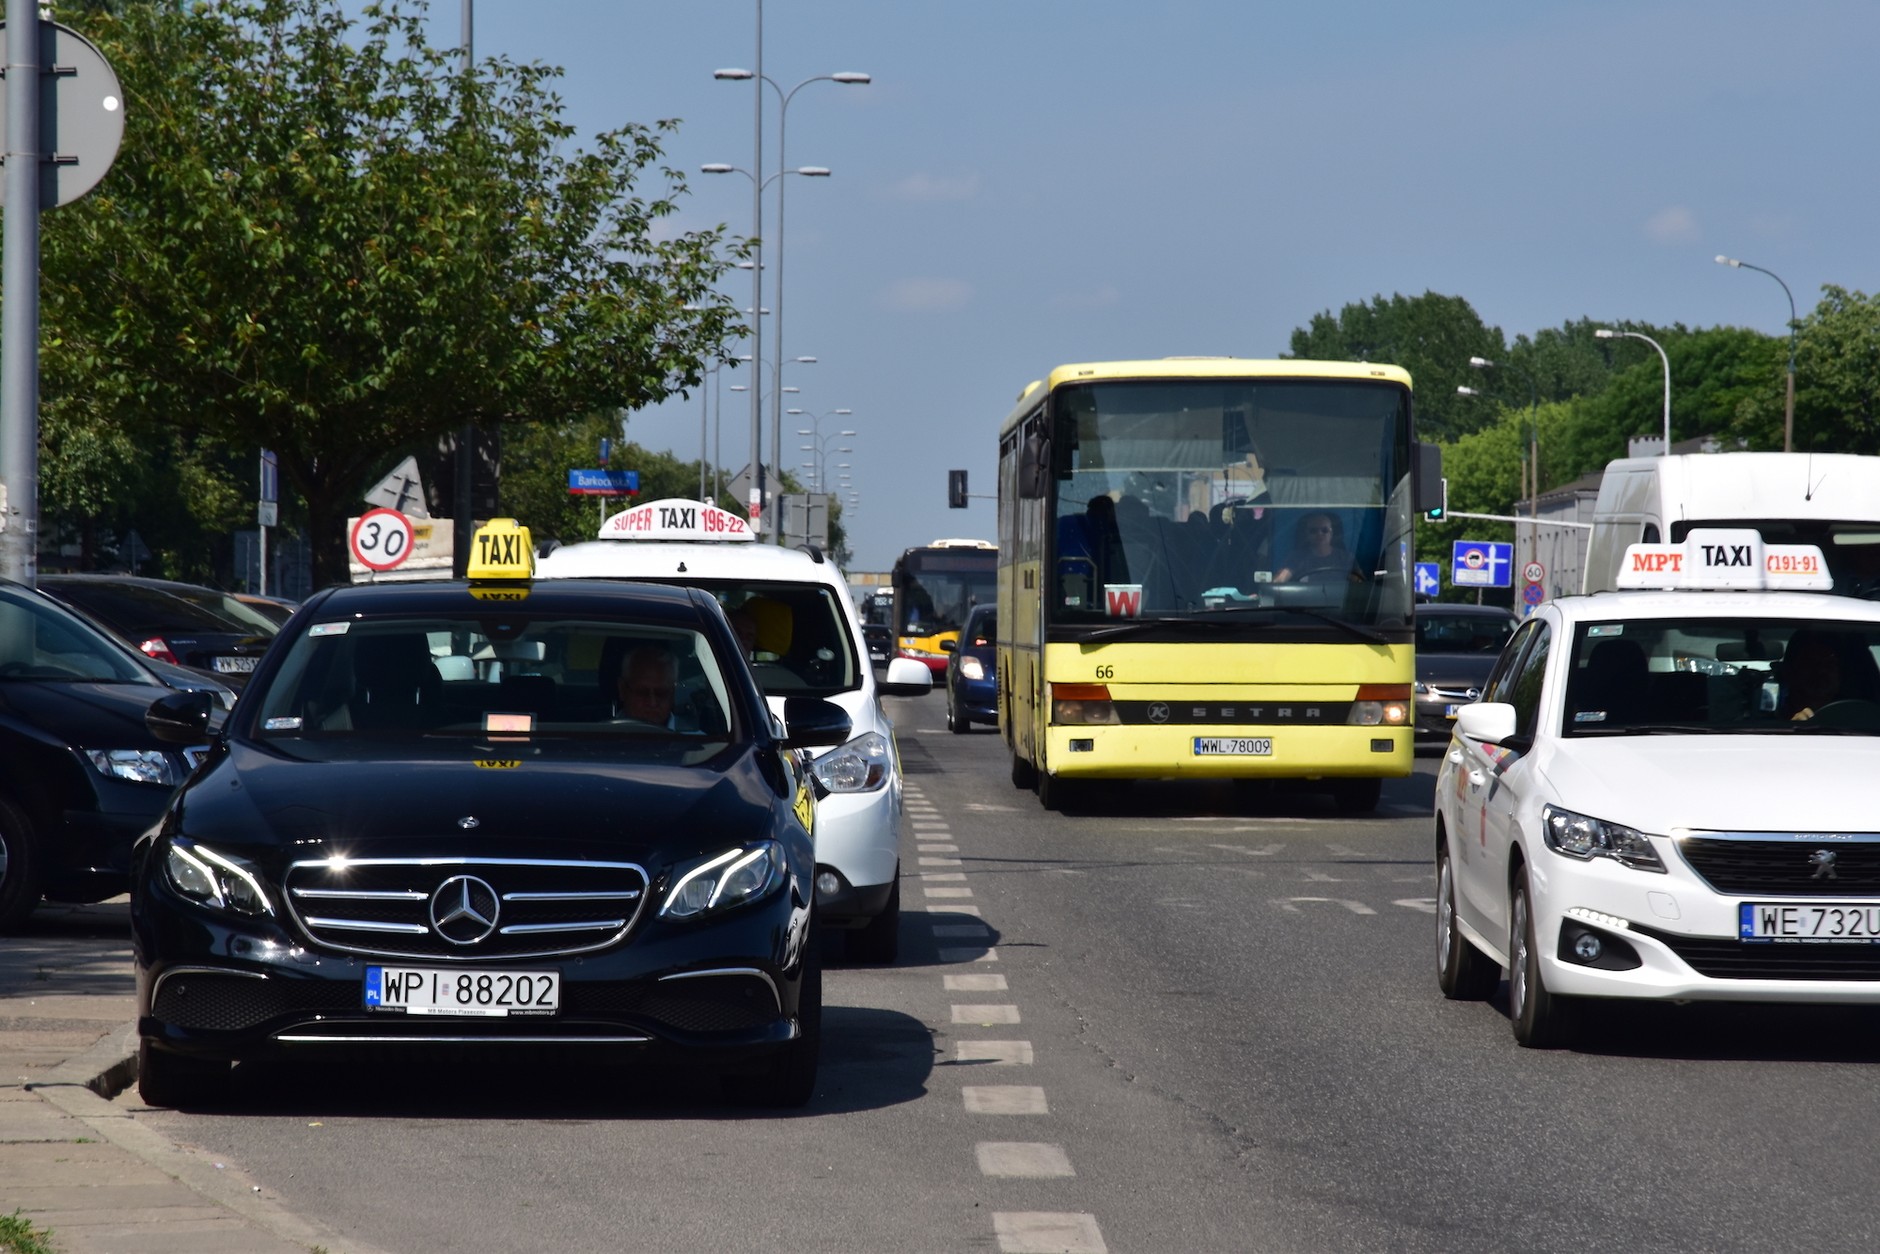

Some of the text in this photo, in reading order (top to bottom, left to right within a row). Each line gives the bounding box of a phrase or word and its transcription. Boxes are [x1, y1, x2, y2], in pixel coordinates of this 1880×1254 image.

[614, 507, 653, 531] SUPER
[659, 507, 696, 529] TAXI
[701, 508, 745, 533] 196-22
[360, 522, 405, 557] 30
[478, 534, 521, 565] TAXI
[1632, 545, 1818, 572] MPT TAXI 191-91
[1527, 567, 1541, 578] 60
[1107, 591, 1141, 618] W
[1095, 664, 1114, 679] 66
[1192, 707, 1321, 718] SETRA
[1201, 740, 1271, 754] WWL 78009
[1741, 924, 1753, 933] PL
[1761, 908, 1880, 936] WE 732U
[367, 989, 380, 1000] PL
[384, 972, 554, 1006] WPI 88202
